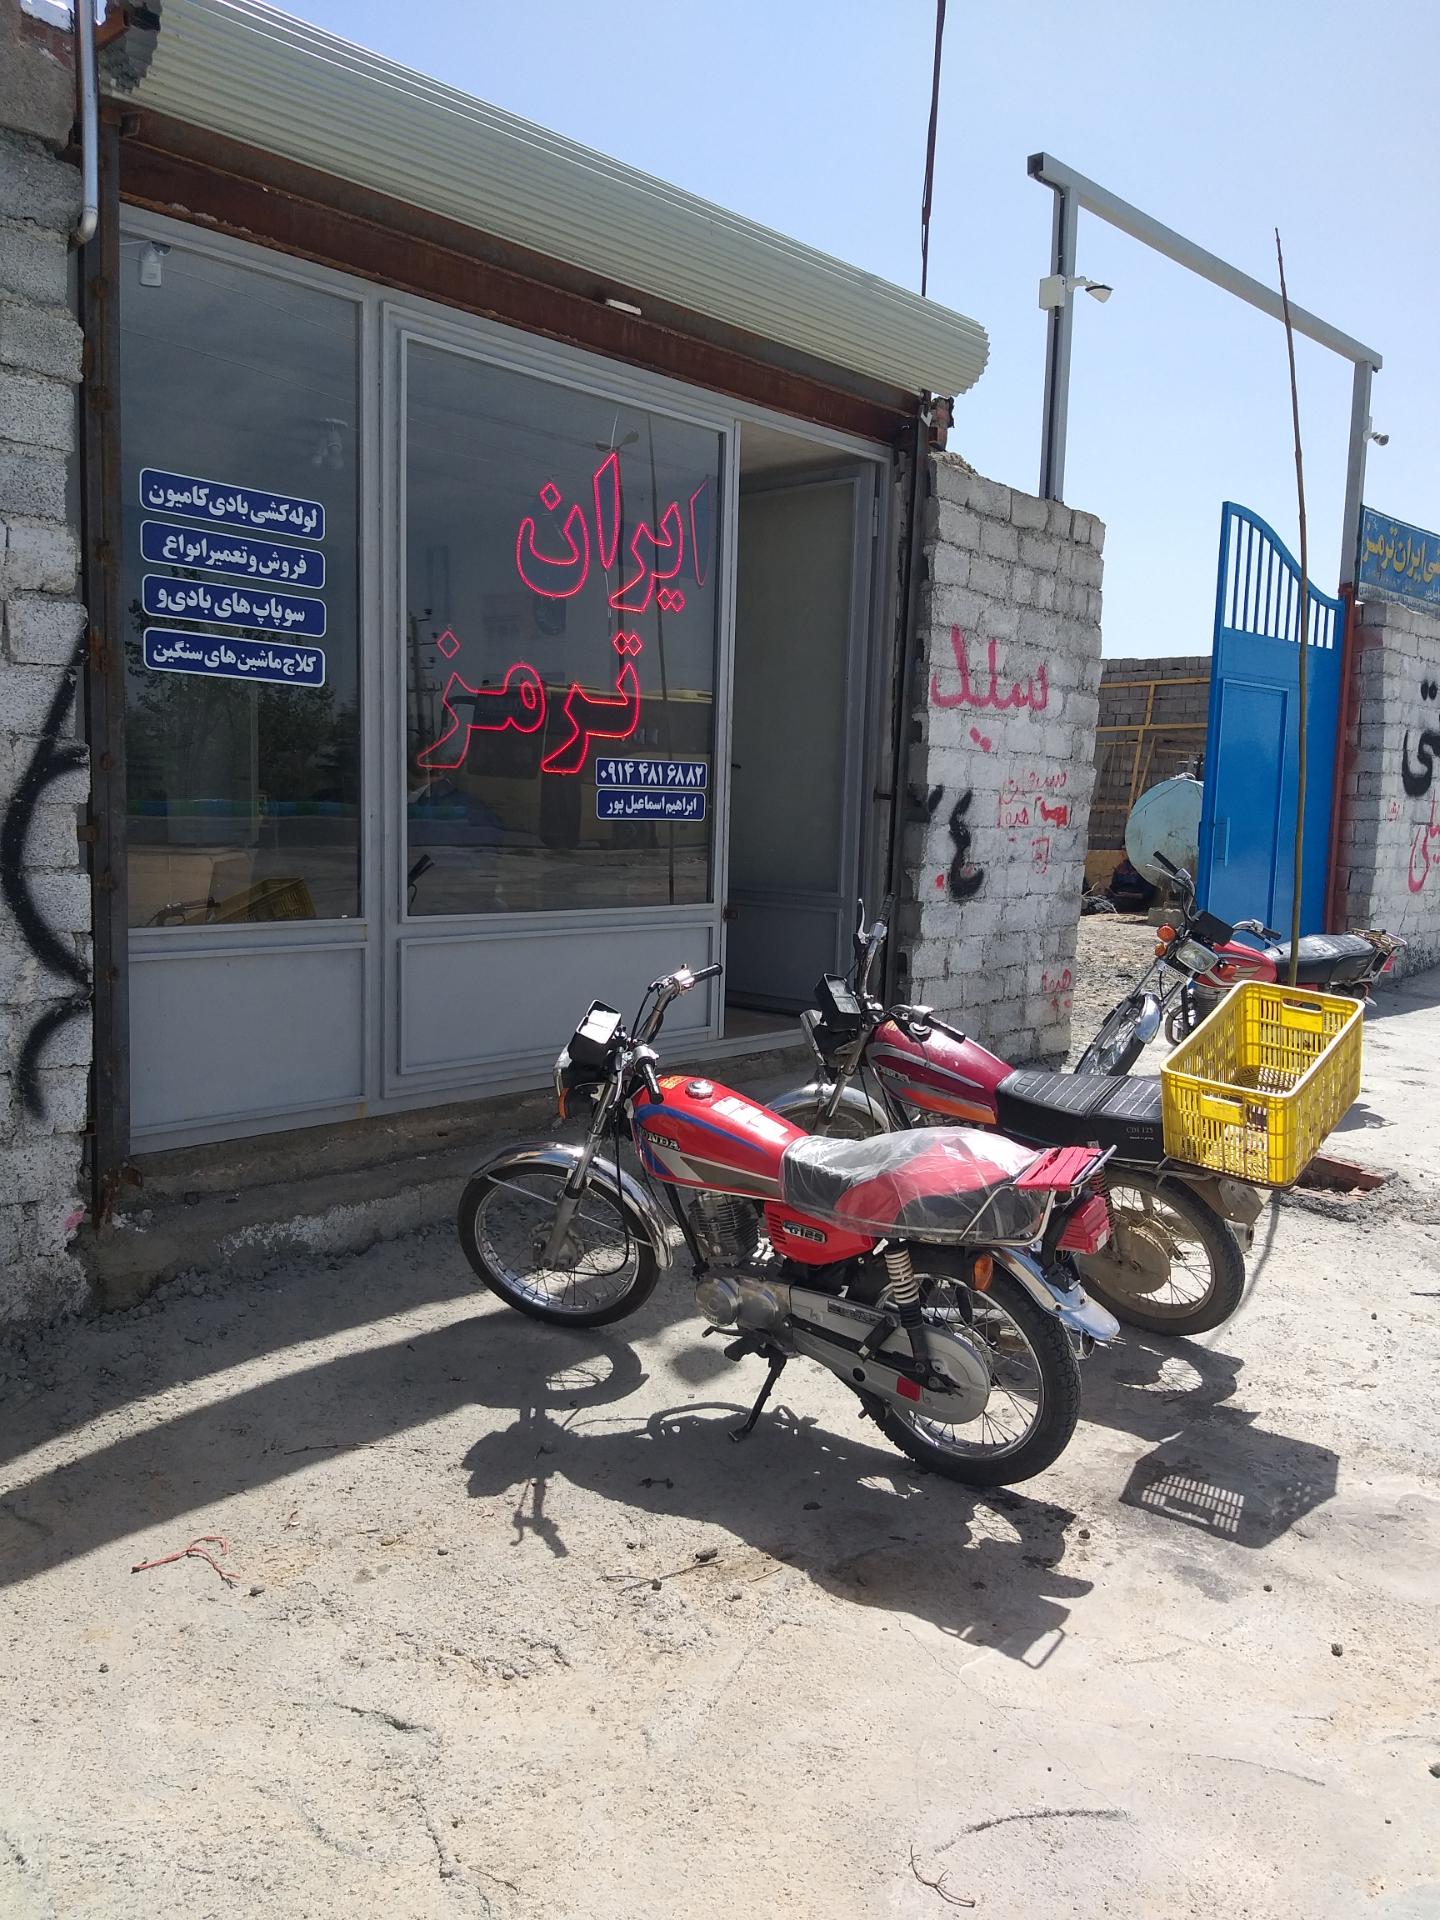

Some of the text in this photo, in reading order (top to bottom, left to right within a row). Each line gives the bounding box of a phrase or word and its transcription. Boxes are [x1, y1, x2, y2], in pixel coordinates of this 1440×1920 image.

[148, 485, 318, 533] لوله کشی بادی کامیون
[515, 452, 713, 613] ایران
[205, 545, 249, 566] تعمیر
[258, 551, 307, 580] فروش
[167, 587, 212, 614] بادی
[214, 592, 251, 618] های
[252, 597, 306, 627] سوپاپ
[153, 641, 317, 676] کلاچ ماشین های سنگین
[416, 629, 645, 775] ترمز
[606, 794, 697, 816] ابراهیم اسماعیل پور
